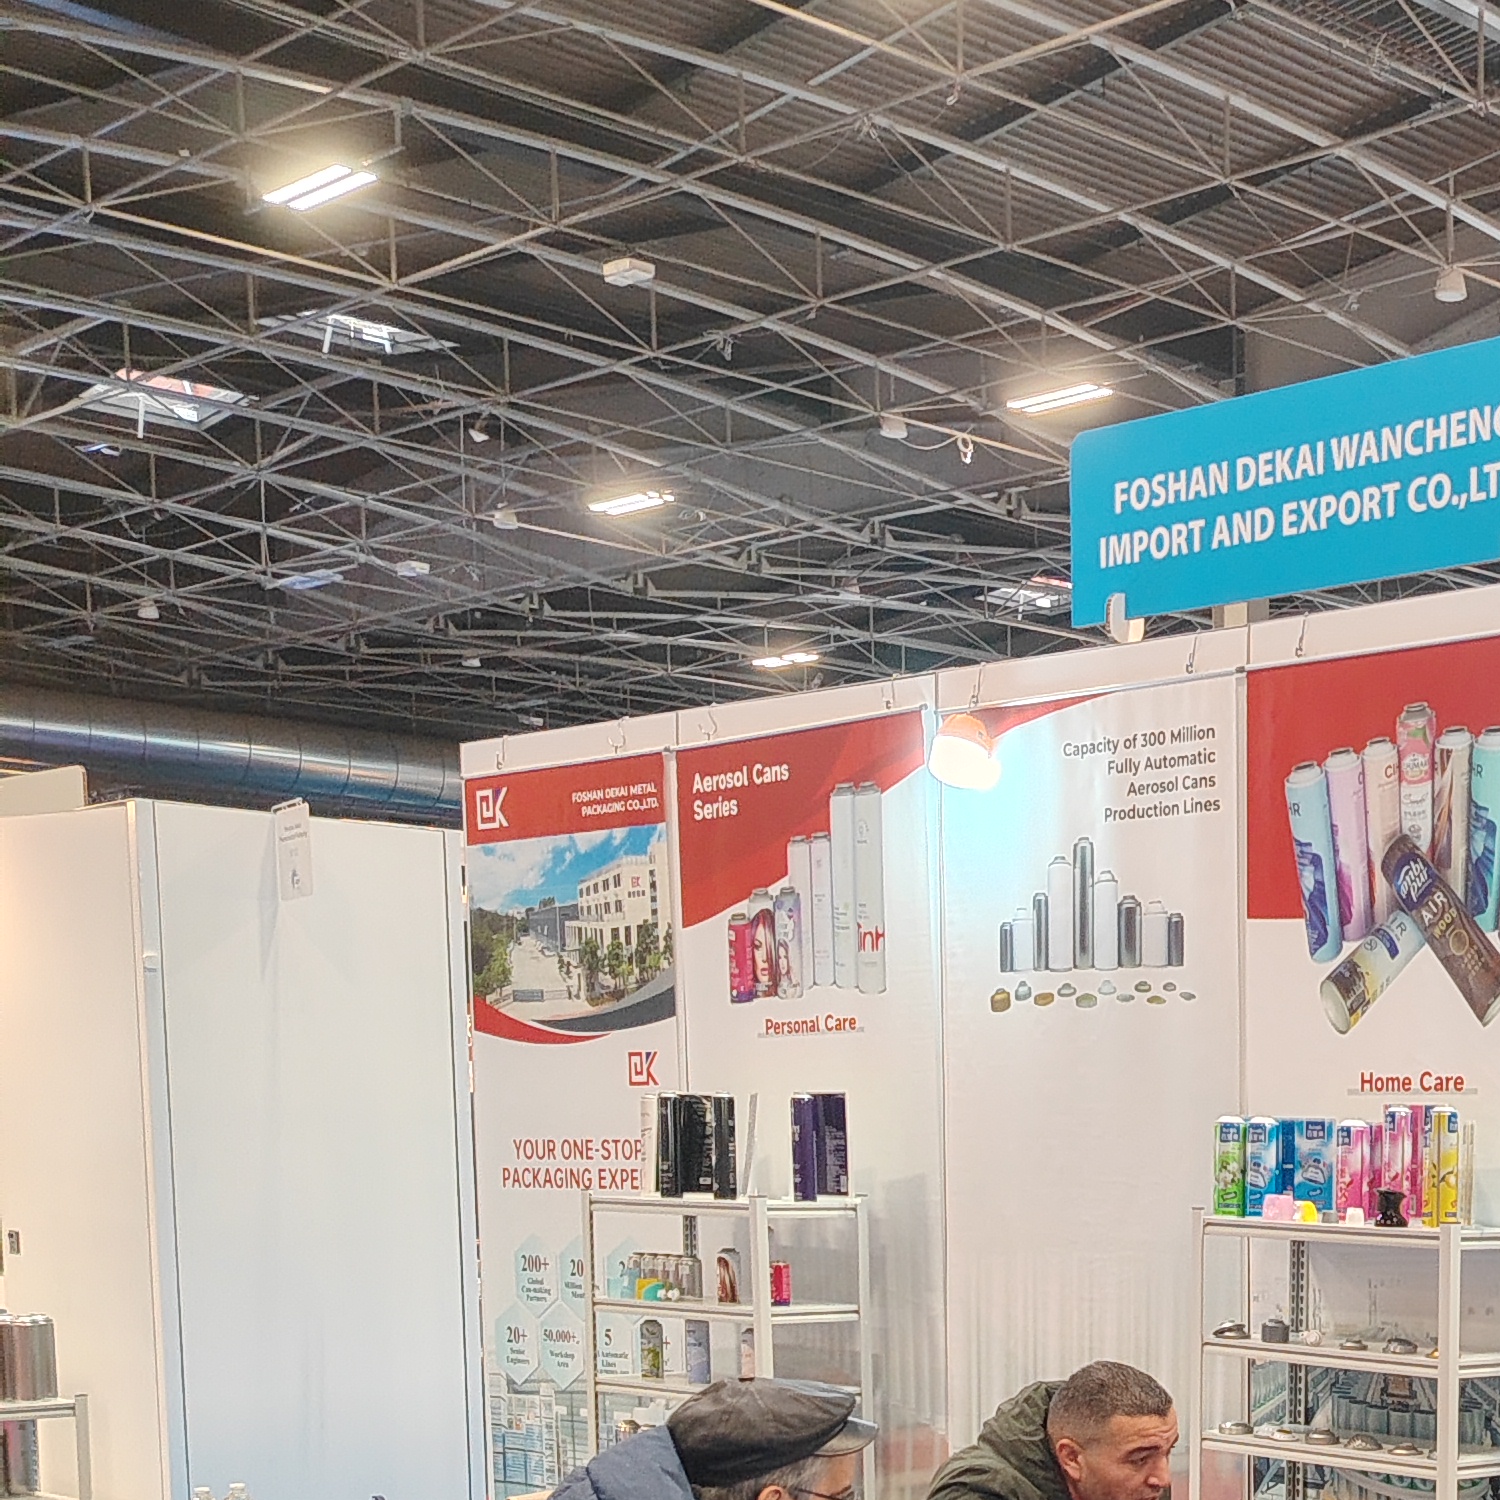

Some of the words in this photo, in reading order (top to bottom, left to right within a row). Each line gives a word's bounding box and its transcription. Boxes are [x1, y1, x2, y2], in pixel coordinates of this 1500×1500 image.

[1114, 460, 1230, 514] FOSHAN
[1236, 440, 1325, 492] DEKAI
[1100, 514, 1207, 569] IMPORT
[1211, 506, 1274, 551] AND
[1281, 482, 1401, 537] EXPORT
[1063, 737, 1119, 759] Capacity
[1123, 735, 1137, 749] of
[1140, 731, 1166, 748] 300
[1170, 726, 1216, 745] Million
[1107, 759, 1140, 776] Fully
[1145, 750, 1216, 771] Automatic
[692, 766, 748, 794] Aerosol
[752, 762, 789, 786] Cans
[1127, 780, 1178, 797] Aerosol
[1182, 775, 1216, 790] Cans
[572, 790, 603, 803] FOSHAN
[605, 787, 628, 799] DEKAI
[630, 782, 657, 795] METAL
[582, 802, 625, 817] PACKAGING
[693, 800, 738, 821] Series
[1104, 804, 1180, 822] Production
[1183, 798, 1221, 814] Lines
[1421, 892, 1448, 926] AIR
[765, 1019, 820, 1036] Personal
[825, 1015, 857, 1034] Care
[1360, 1071, 1412, 1093] Home
[1419, 1071, 1465, 1093] Care
[513, 1139, 556, 1160] YOUR
[561, 1139, 642, 1160] ONE-STOP
[502, 1167, 592, 1190] PACKAGING
[598, 1168, 642, 1190] EXPE
[521, 1255, 549, 1272] 200+
[506, 1326, 528, 1344] 20+
